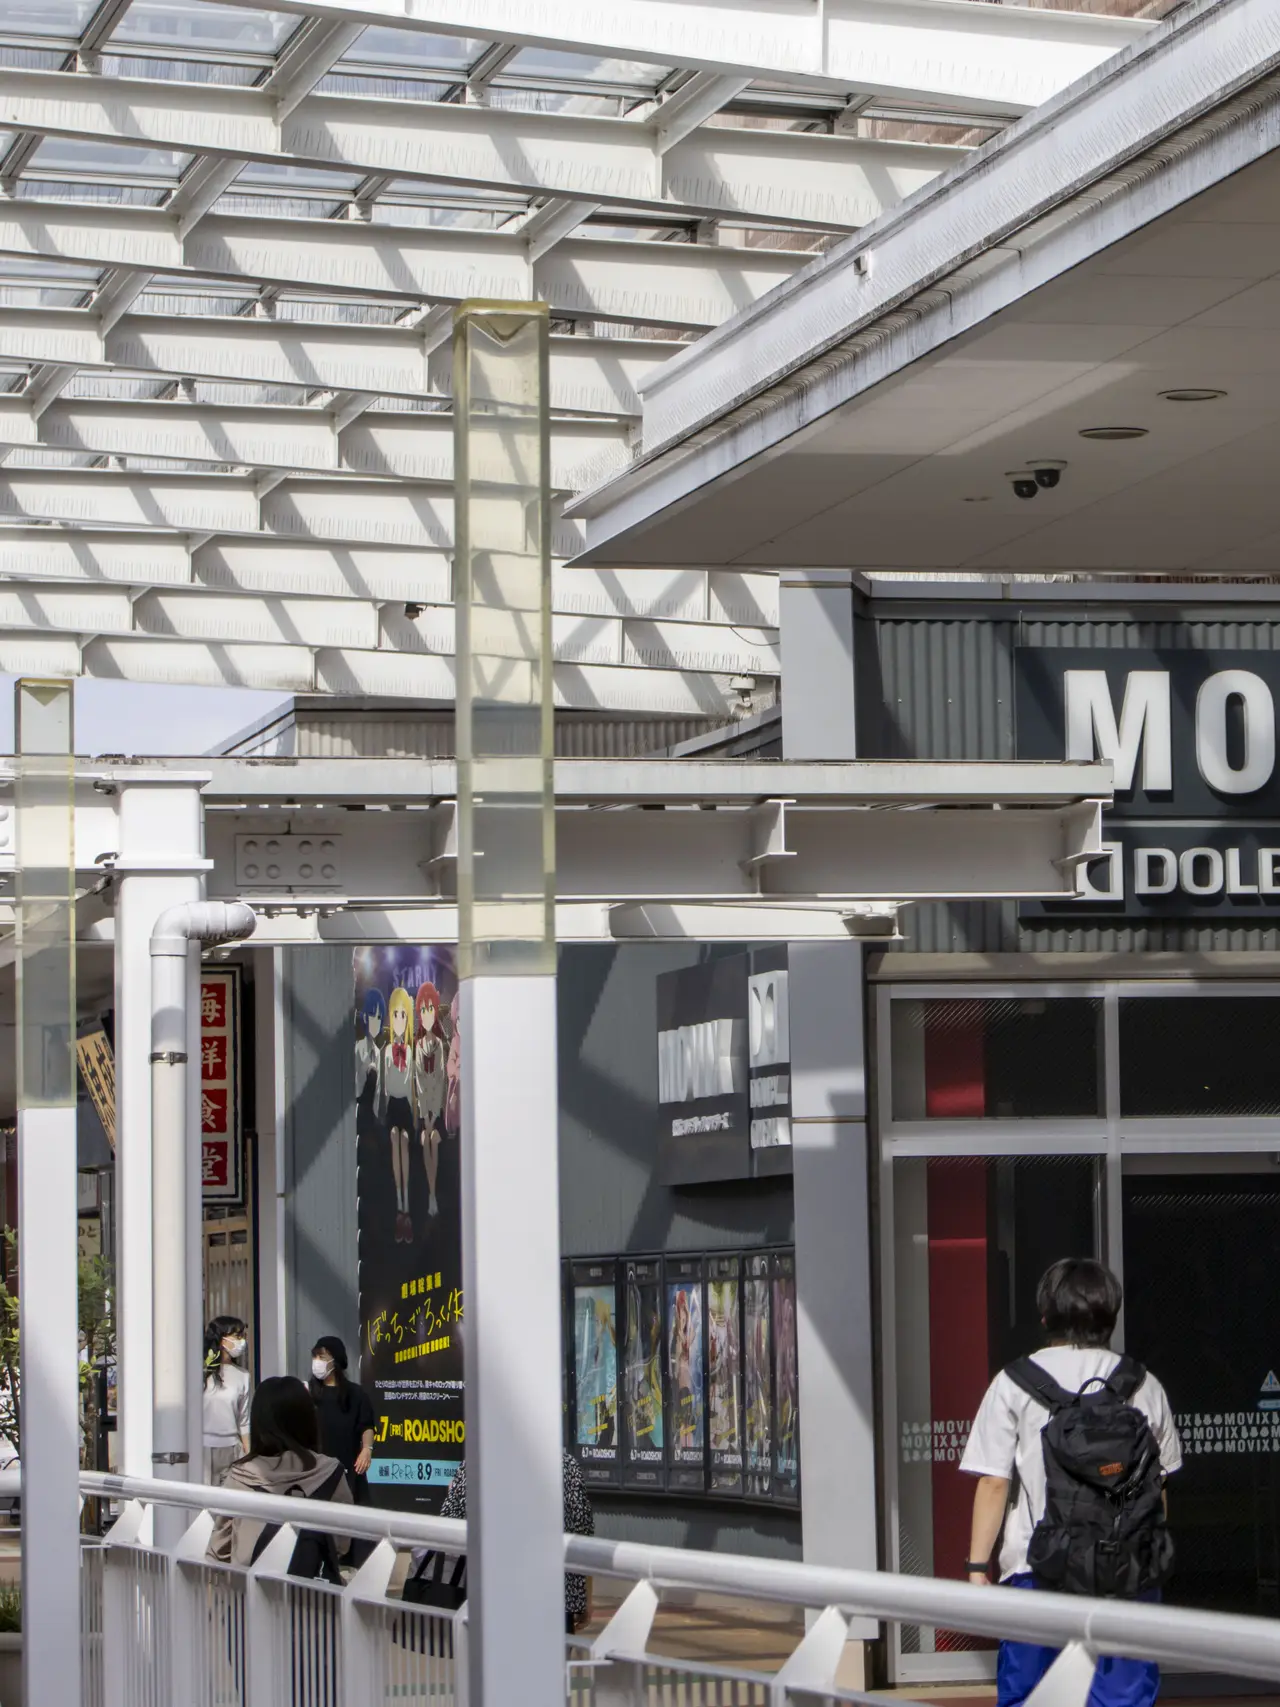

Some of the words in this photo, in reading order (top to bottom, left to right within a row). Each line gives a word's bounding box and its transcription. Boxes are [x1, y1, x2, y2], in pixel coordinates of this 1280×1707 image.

[1224, 1411, 1270, 1425] MOVIX
[404, 1418, 465, 1443] ROADSHO
[933, 1420, 971, 1434] MOVI
[1193, 1426, 1239, 1440] MOVIX
[901, 1435, 948, 1449] MOVIX
[1225, 1440, 1270, 1453] MOVIX
[934, 1448, 964, 1462] MOV
[417, 1462, 432, 1481] 8.9
